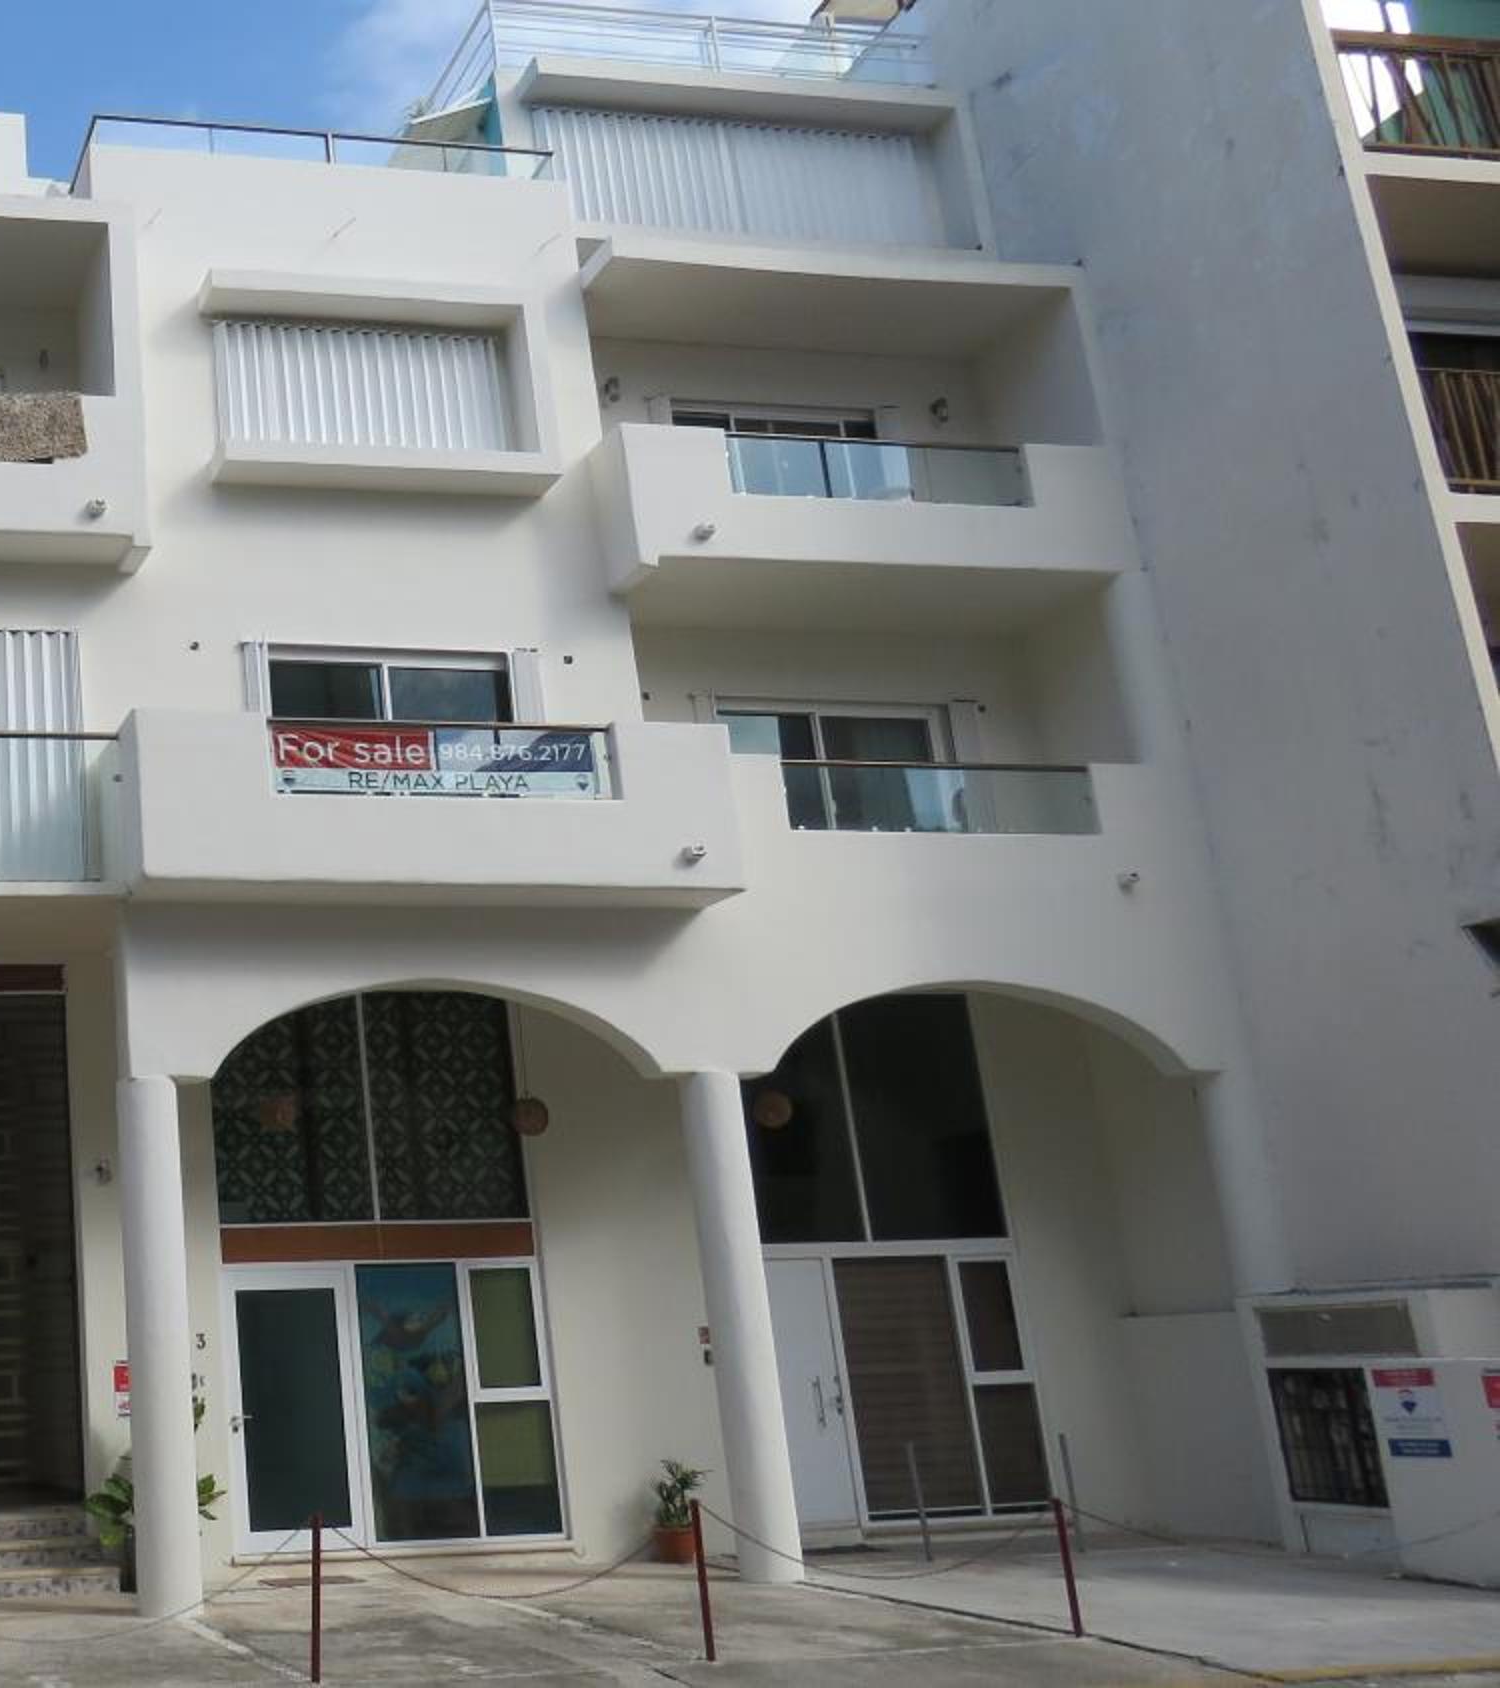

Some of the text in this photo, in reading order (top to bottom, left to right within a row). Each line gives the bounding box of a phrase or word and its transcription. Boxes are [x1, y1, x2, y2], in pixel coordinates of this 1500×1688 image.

[276, 734, 426, 764] For sale
[439, 743, 586, 762] 984.876.2177
[348, 771, 530, 791] RE/MAX PLAYA
[196, 1333, 207, 1350] 3
